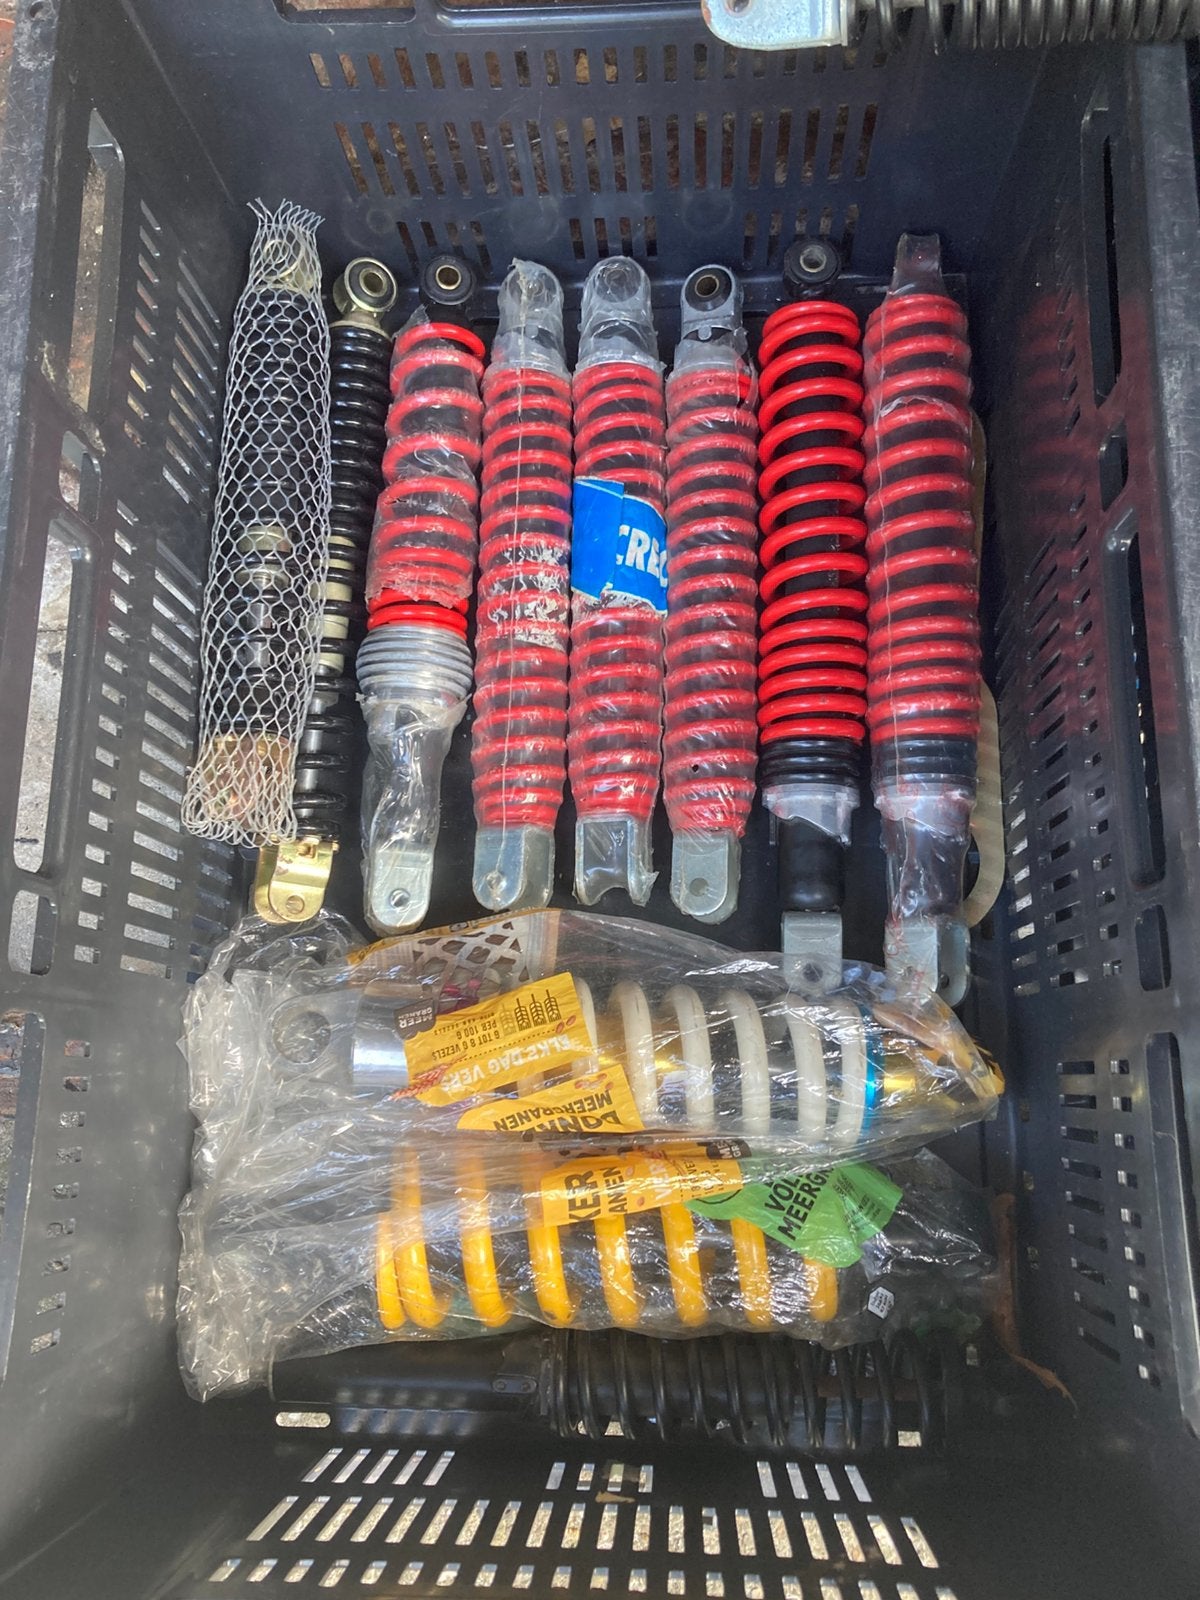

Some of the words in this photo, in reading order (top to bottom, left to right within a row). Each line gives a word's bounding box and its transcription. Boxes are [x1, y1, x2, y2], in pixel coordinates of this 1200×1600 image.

[399, 1013, 433, 1029] MEER
[484, 1019, 498, 1032] PER
[463, 1023, 480, 1038] 100
[469, 1038, 477, 1049] 8
[478, 1031, 494, 1046] TOT
[431, 1041, 461, 1061] VEZELS
[487, 1046, 523, 1075] DAG
[493, 1088, 614, 1132] MEERGRANEN
